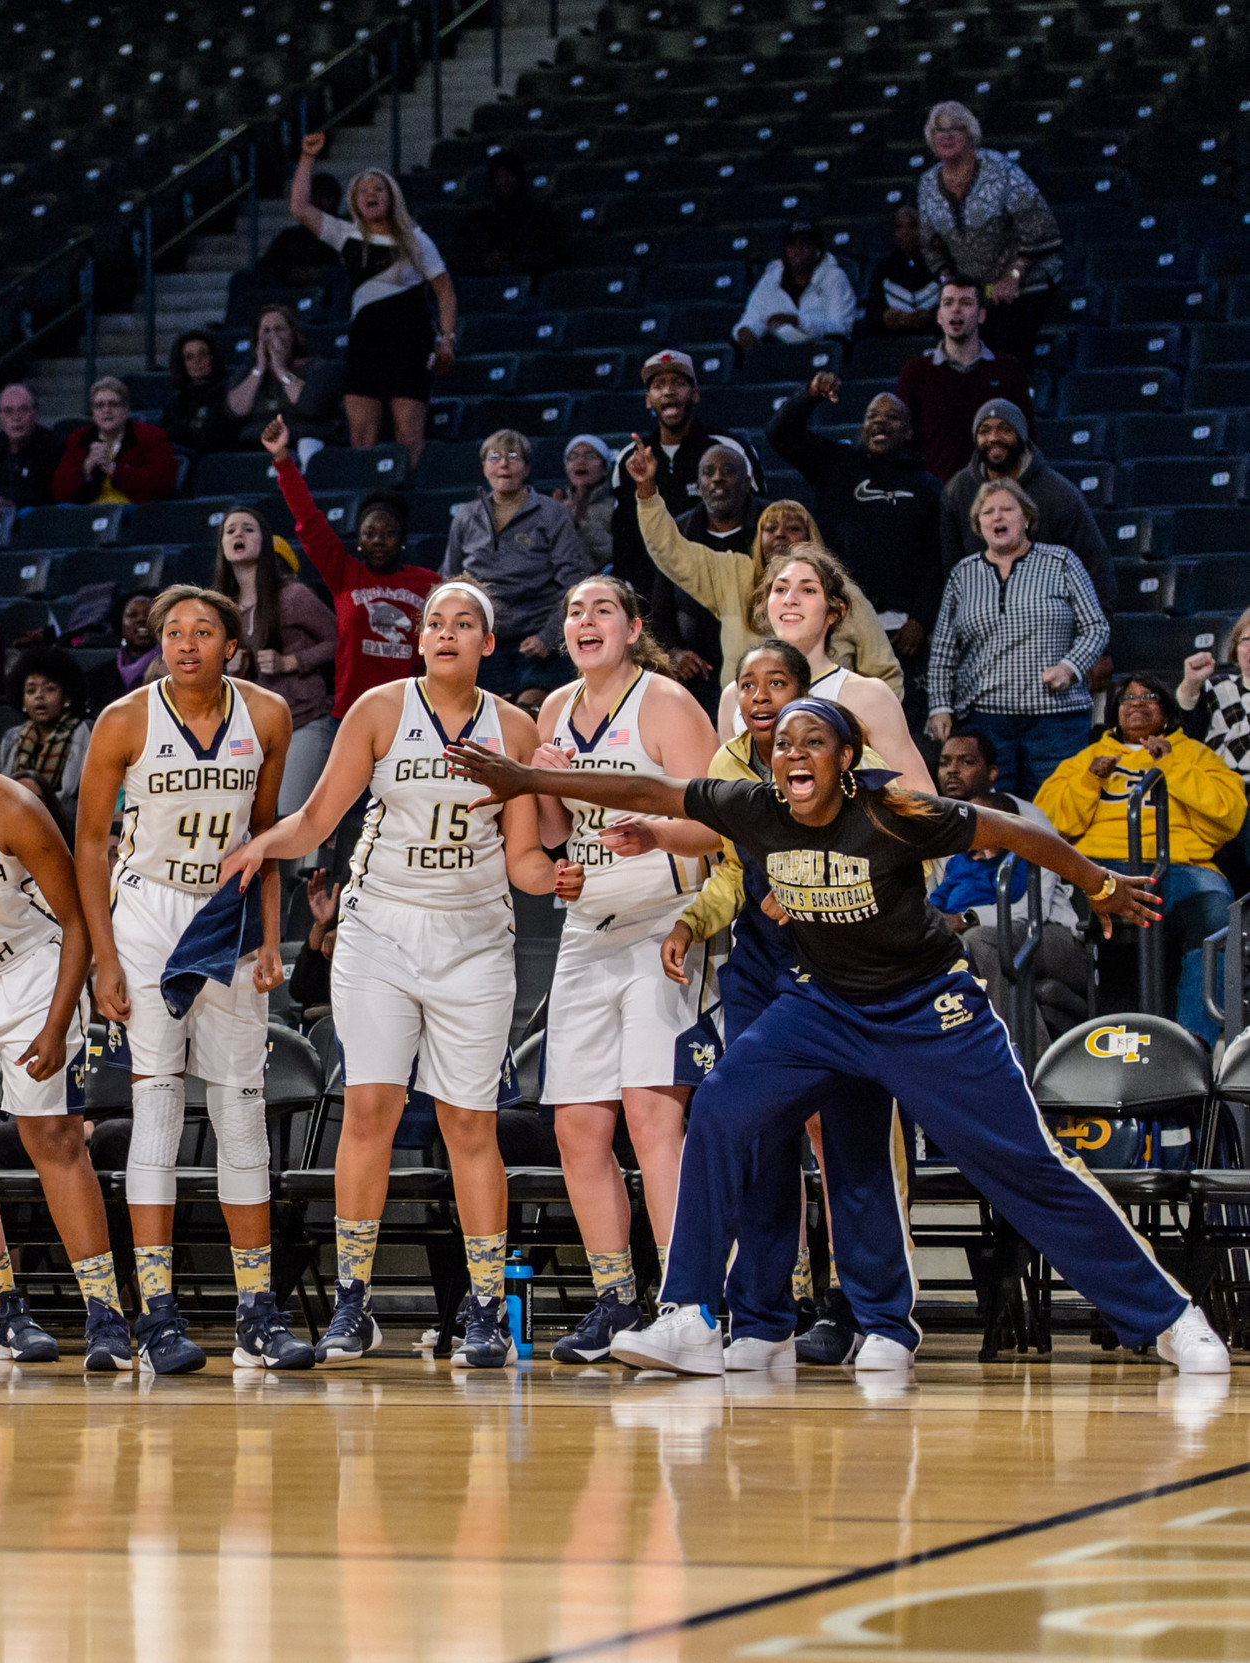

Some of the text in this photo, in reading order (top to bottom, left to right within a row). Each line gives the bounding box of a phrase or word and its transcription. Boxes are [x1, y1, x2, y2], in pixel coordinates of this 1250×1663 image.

[149, 768, 256, 794] GEORGIA
[178, 810, 232, 850] 44
[430, 803, 472, 842] 15
[406, 847, 474, 869] TECH
[767, 849, 871, 886] GEORGIA TECH
[811, 886, 872, 908] BASKETBALL
[821, 902, 879, 924] JACKETS
[1117, 1036, 1134, 1049] KP
